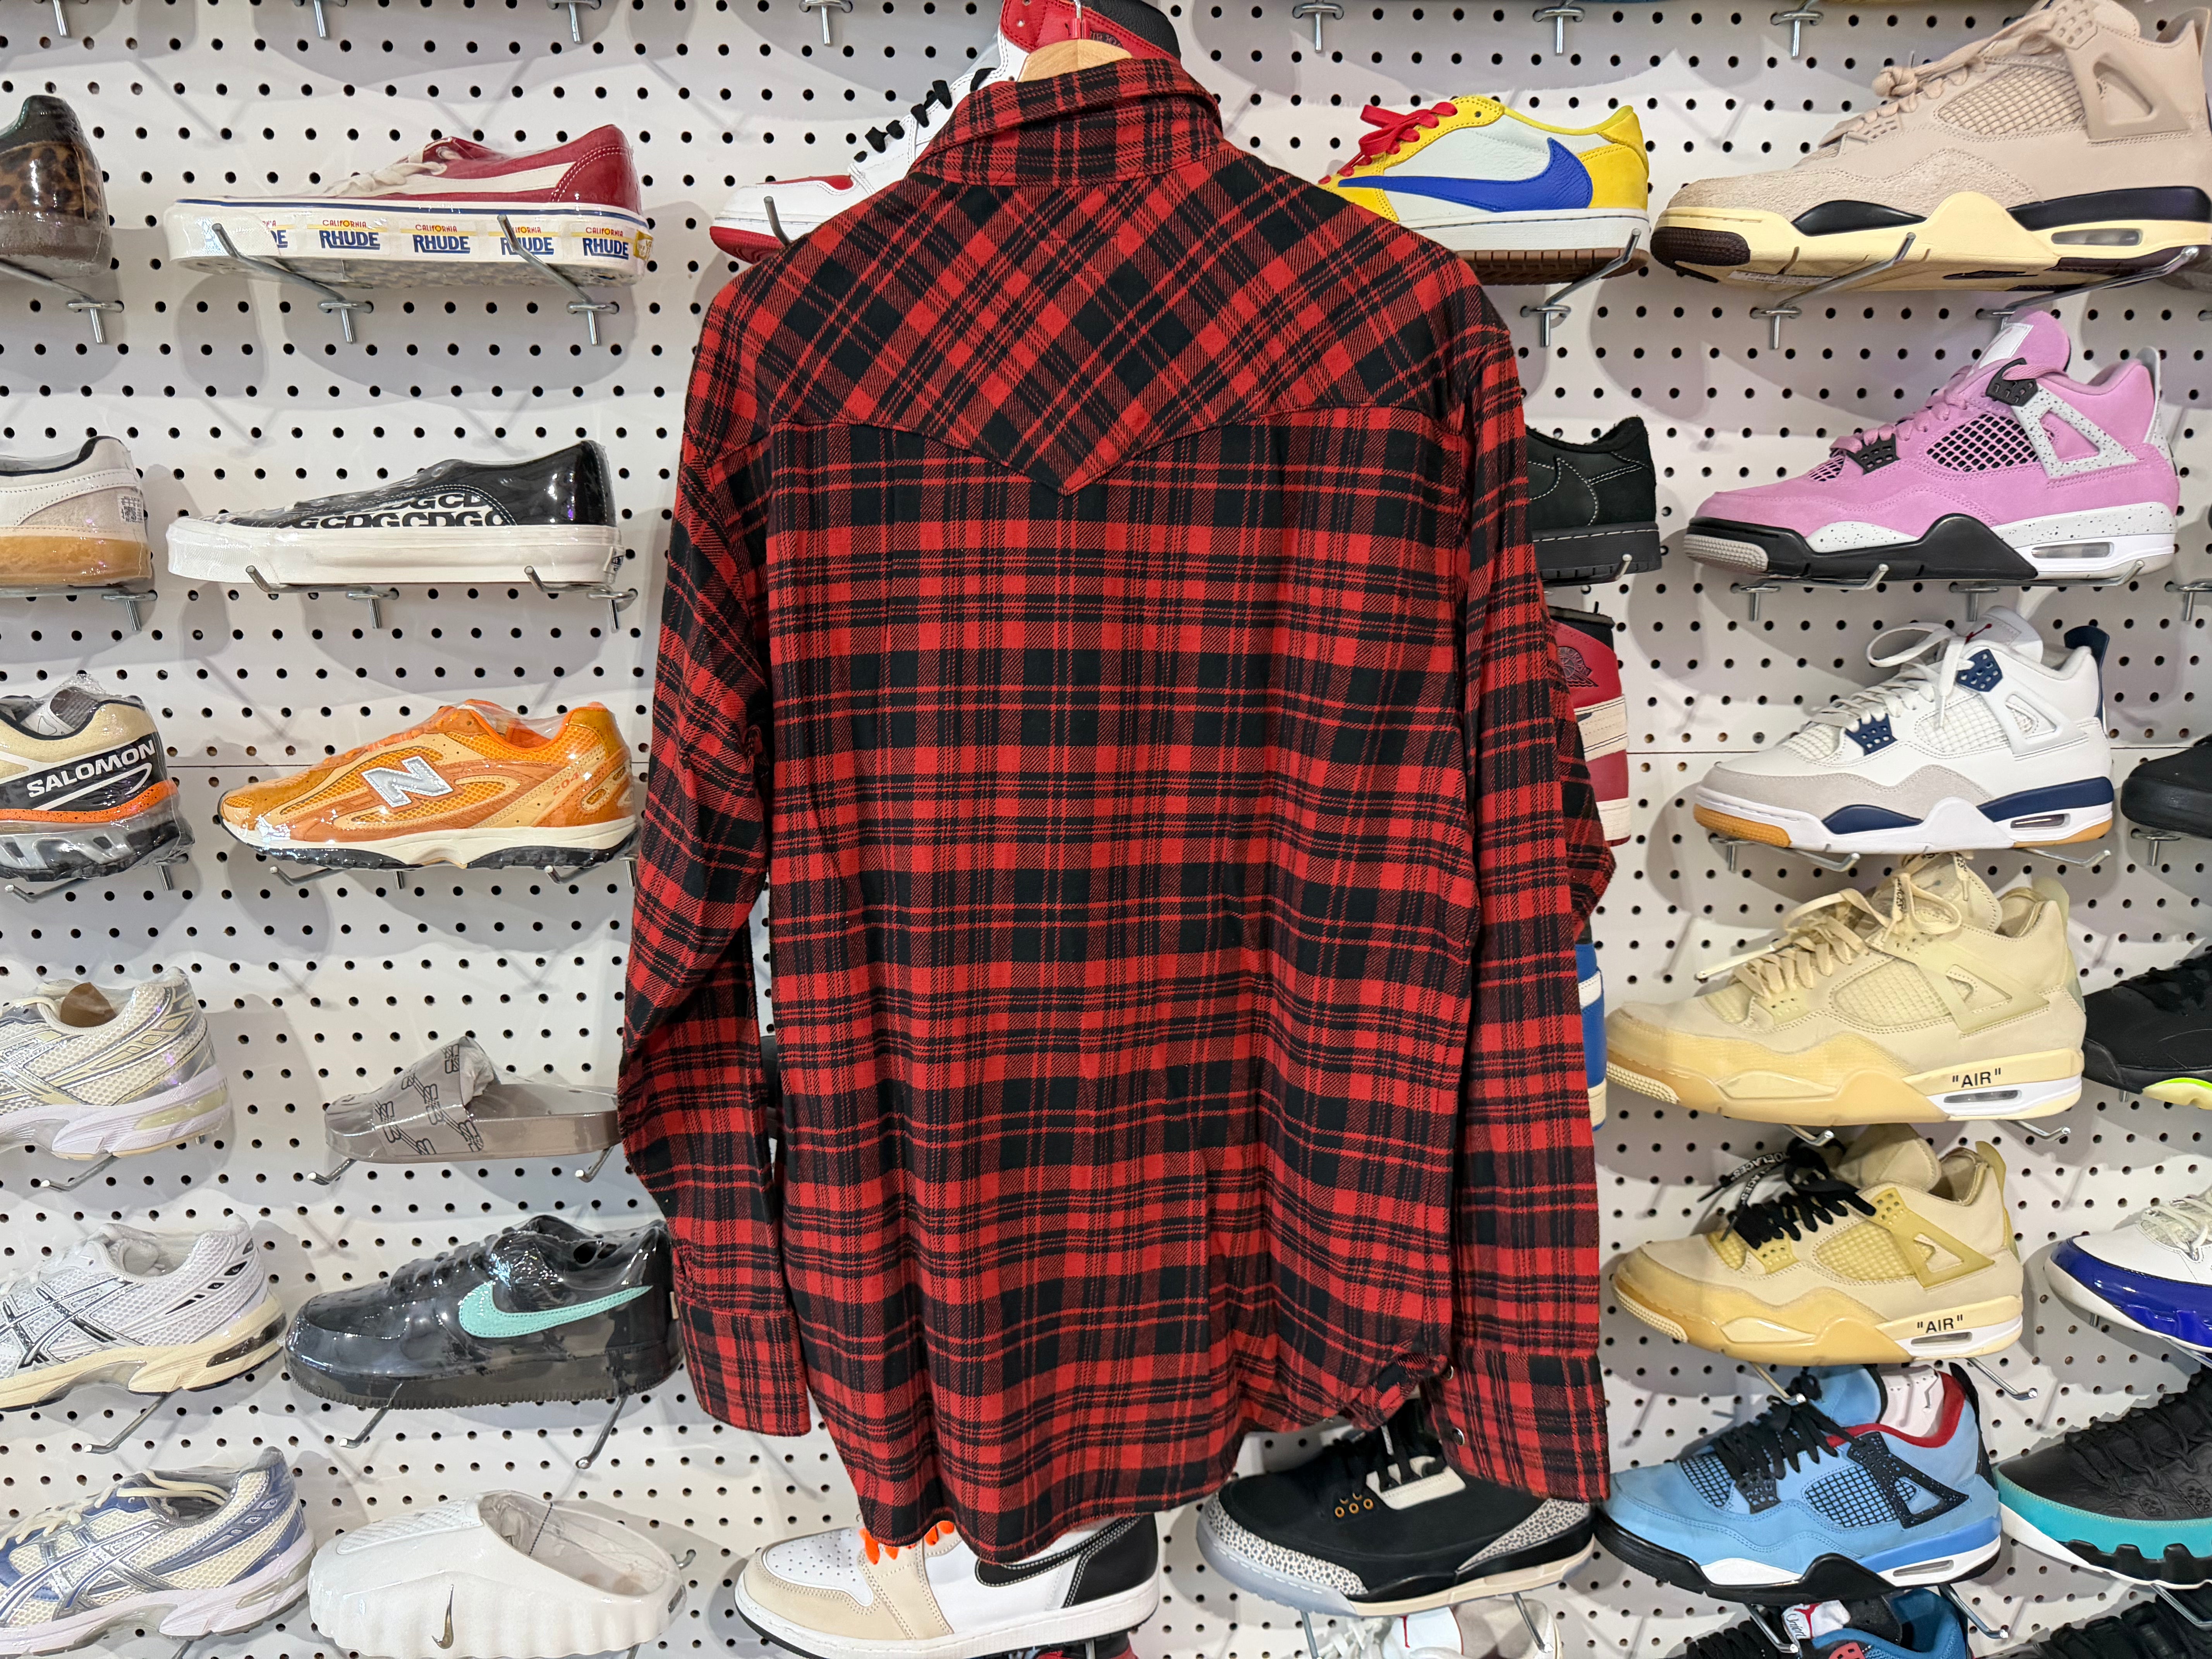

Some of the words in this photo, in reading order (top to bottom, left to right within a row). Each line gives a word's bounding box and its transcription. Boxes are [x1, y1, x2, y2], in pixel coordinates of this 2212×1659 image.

[323, 220, 366, 228] CALIFORNIA
[415, 224, 457, 232] CALIFORNIA
[586, 227, 623, 237] CALIFORNIA
[319, 230, 380, 250] RHUDE
[412, 234, 471, 254] RHUDE
[582, 237, 629, 260] RHUDE
[27, 740, 156, 798] SALOMON
[1952, 1067, 2001, 1088] "AIR"
[1917, 1314, 1963, 1333] "AIR"
